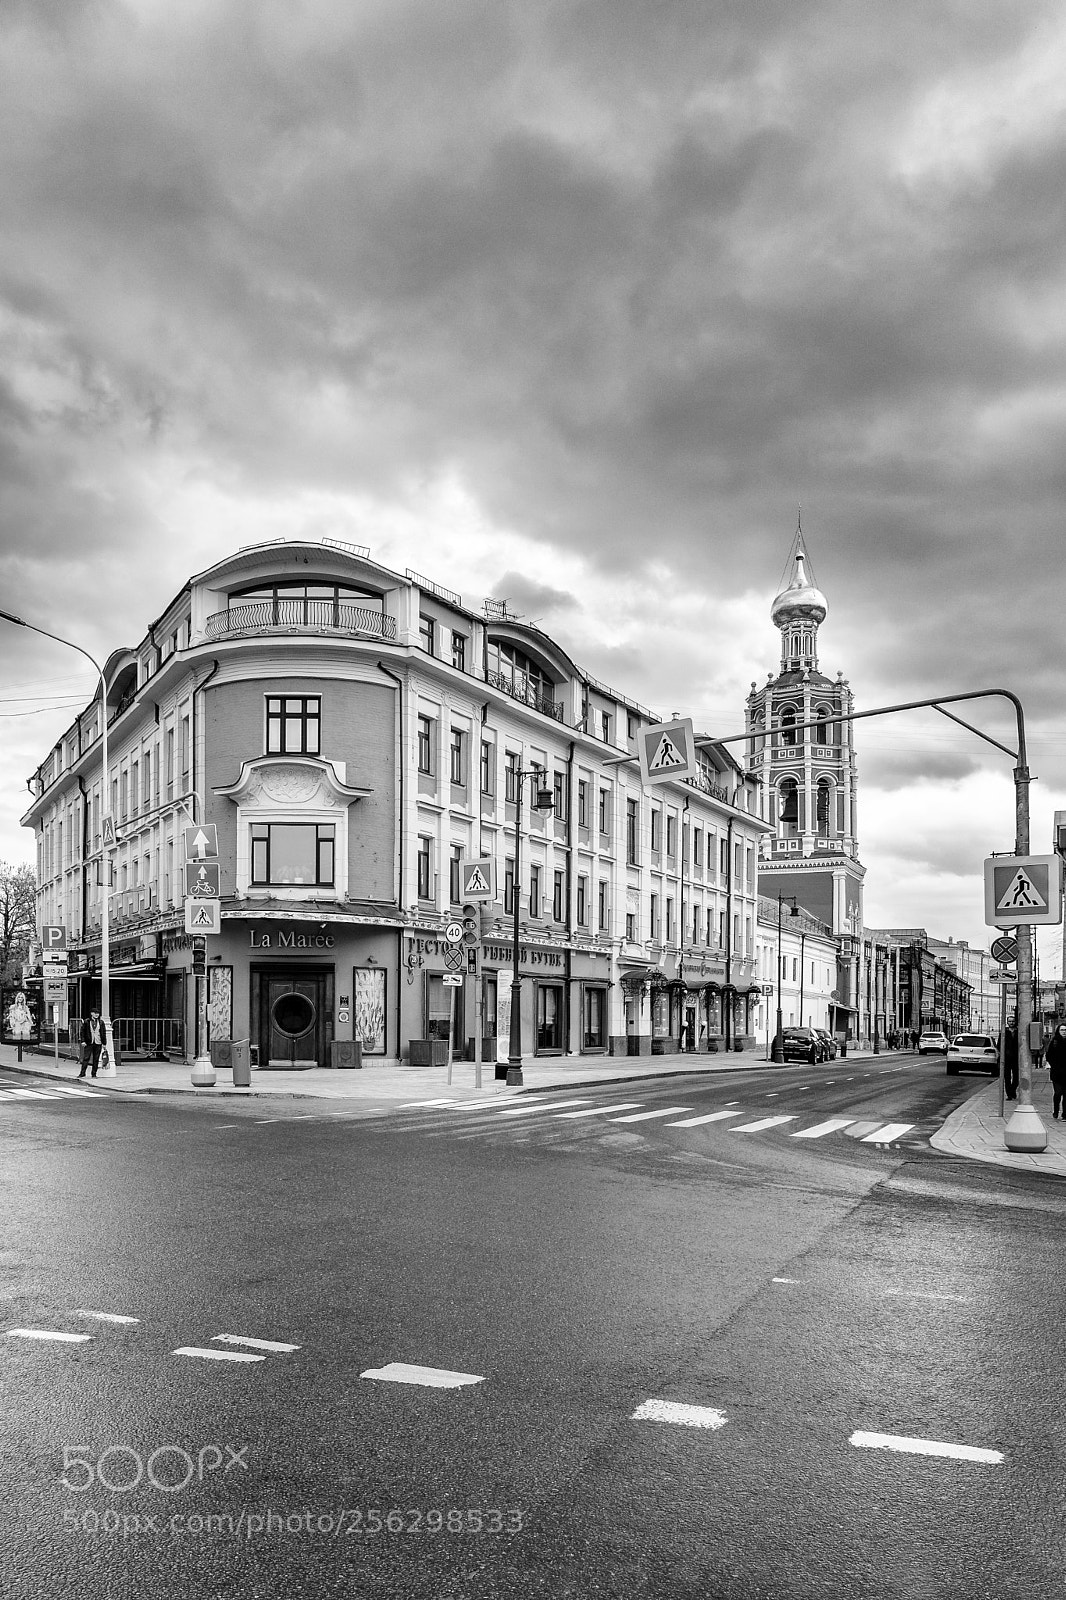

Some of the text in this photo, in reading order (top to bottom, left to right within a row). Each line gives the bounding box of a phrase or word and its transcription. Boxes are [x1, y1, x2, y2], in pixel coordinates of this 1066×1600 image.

[249, 929, 335, 948] La Marée
[448, 928, 460, 937] 40
[483, 945, 527, 964] РЫБНЙ
